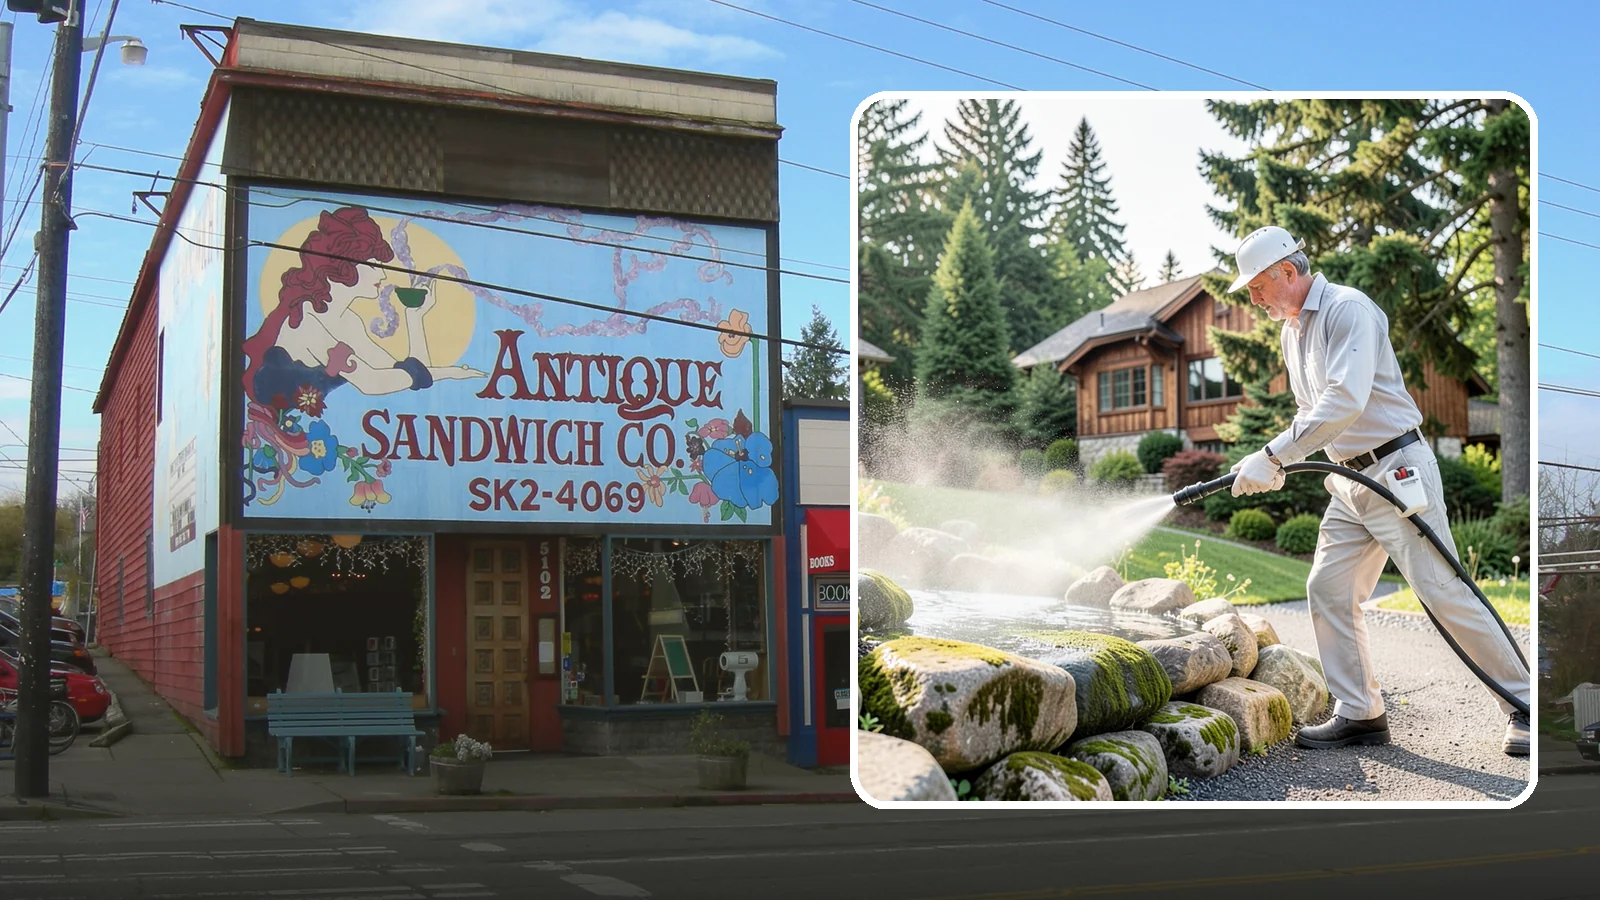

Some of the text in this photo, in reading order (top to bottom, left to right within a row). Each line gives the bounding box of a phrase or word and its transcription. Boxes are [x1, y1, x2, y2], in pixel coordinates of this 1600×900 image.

[475, 329, 724, 421] ANTIQUE
[361, 408, 685, 469] SANDWICH CO.
[468, 476, 646, 513] SK2-4069
[539, 541, 552, 600] 5102
[809, 555, 835, 569] BOOKS
